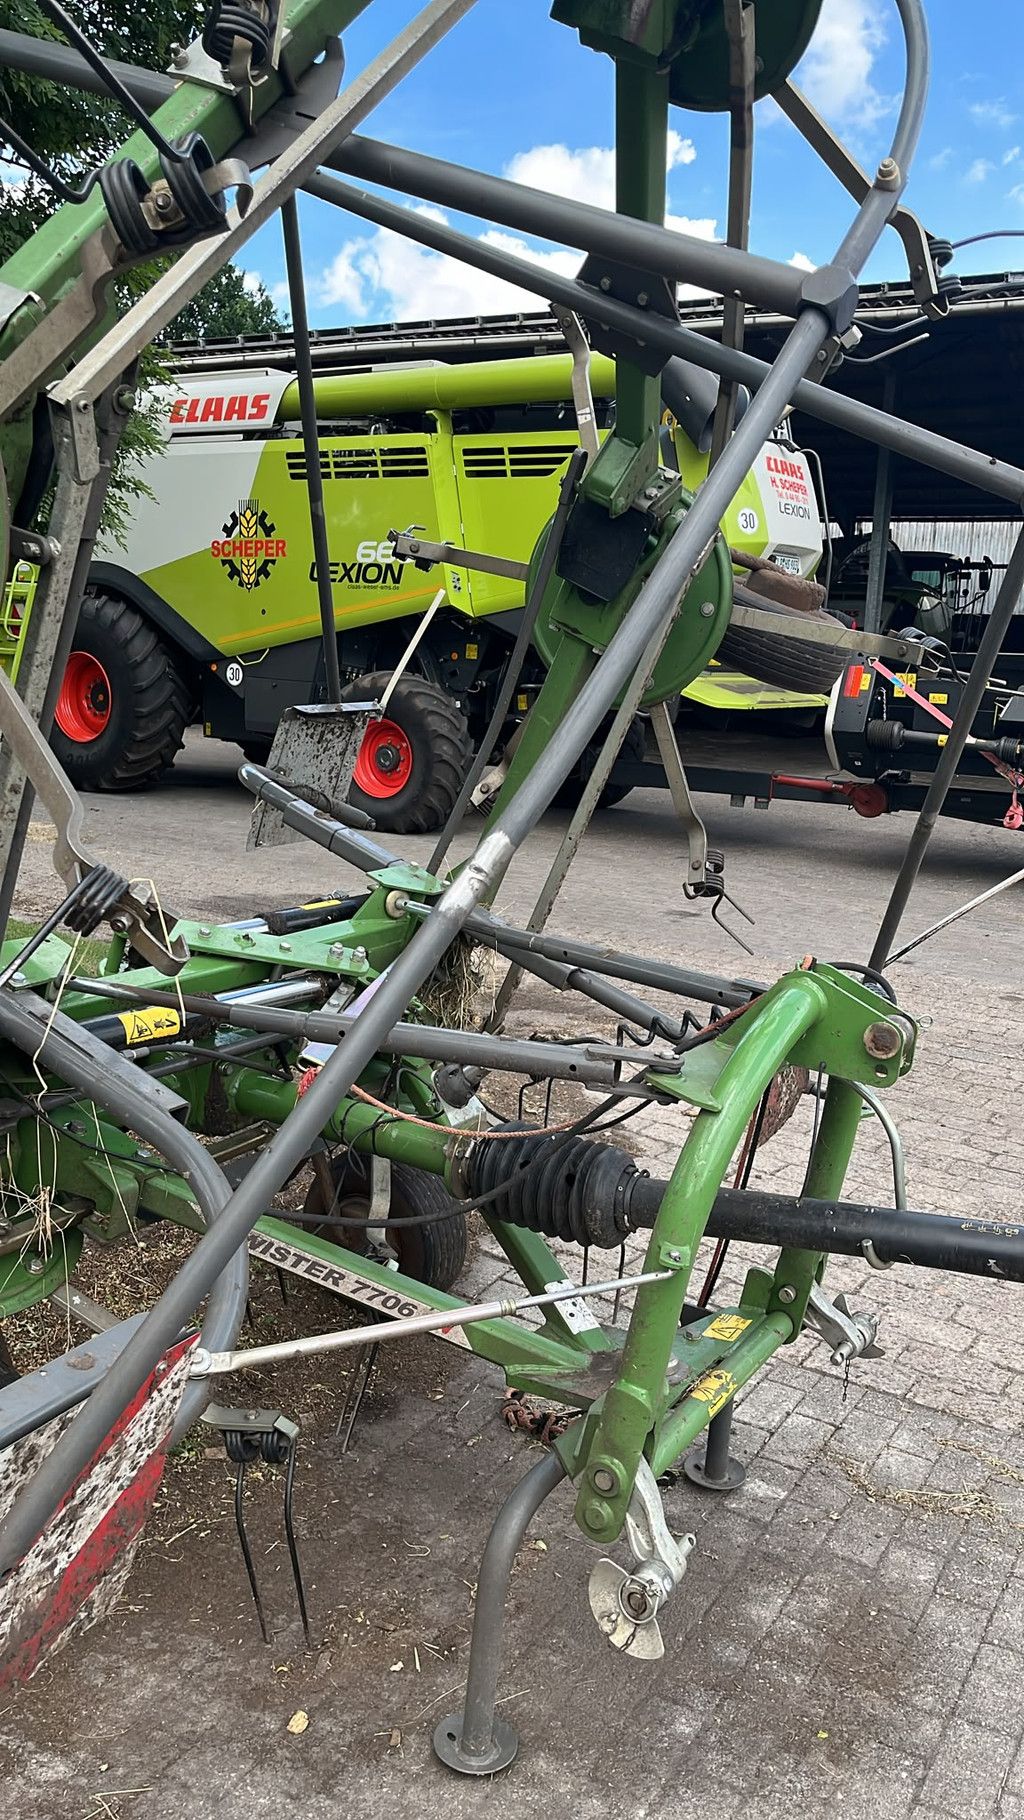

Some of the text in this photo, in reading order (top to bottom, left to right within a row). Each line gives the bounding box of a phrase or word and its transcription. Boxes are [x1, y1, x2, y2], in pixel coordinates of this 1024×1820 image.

[169, 394, 271, 424] CLAAS
[766, 456, 804, 481] CLAAS
[779, 478, 808, 496] SCHEPER
[778, 501, 811, 520] LEXION
[740, 512, 755, 529] 30
[211, 539, 287, 558] SCHEPER
[229, 667, 240, 682] 30
[350, 1279, 418, 1317] 7706
